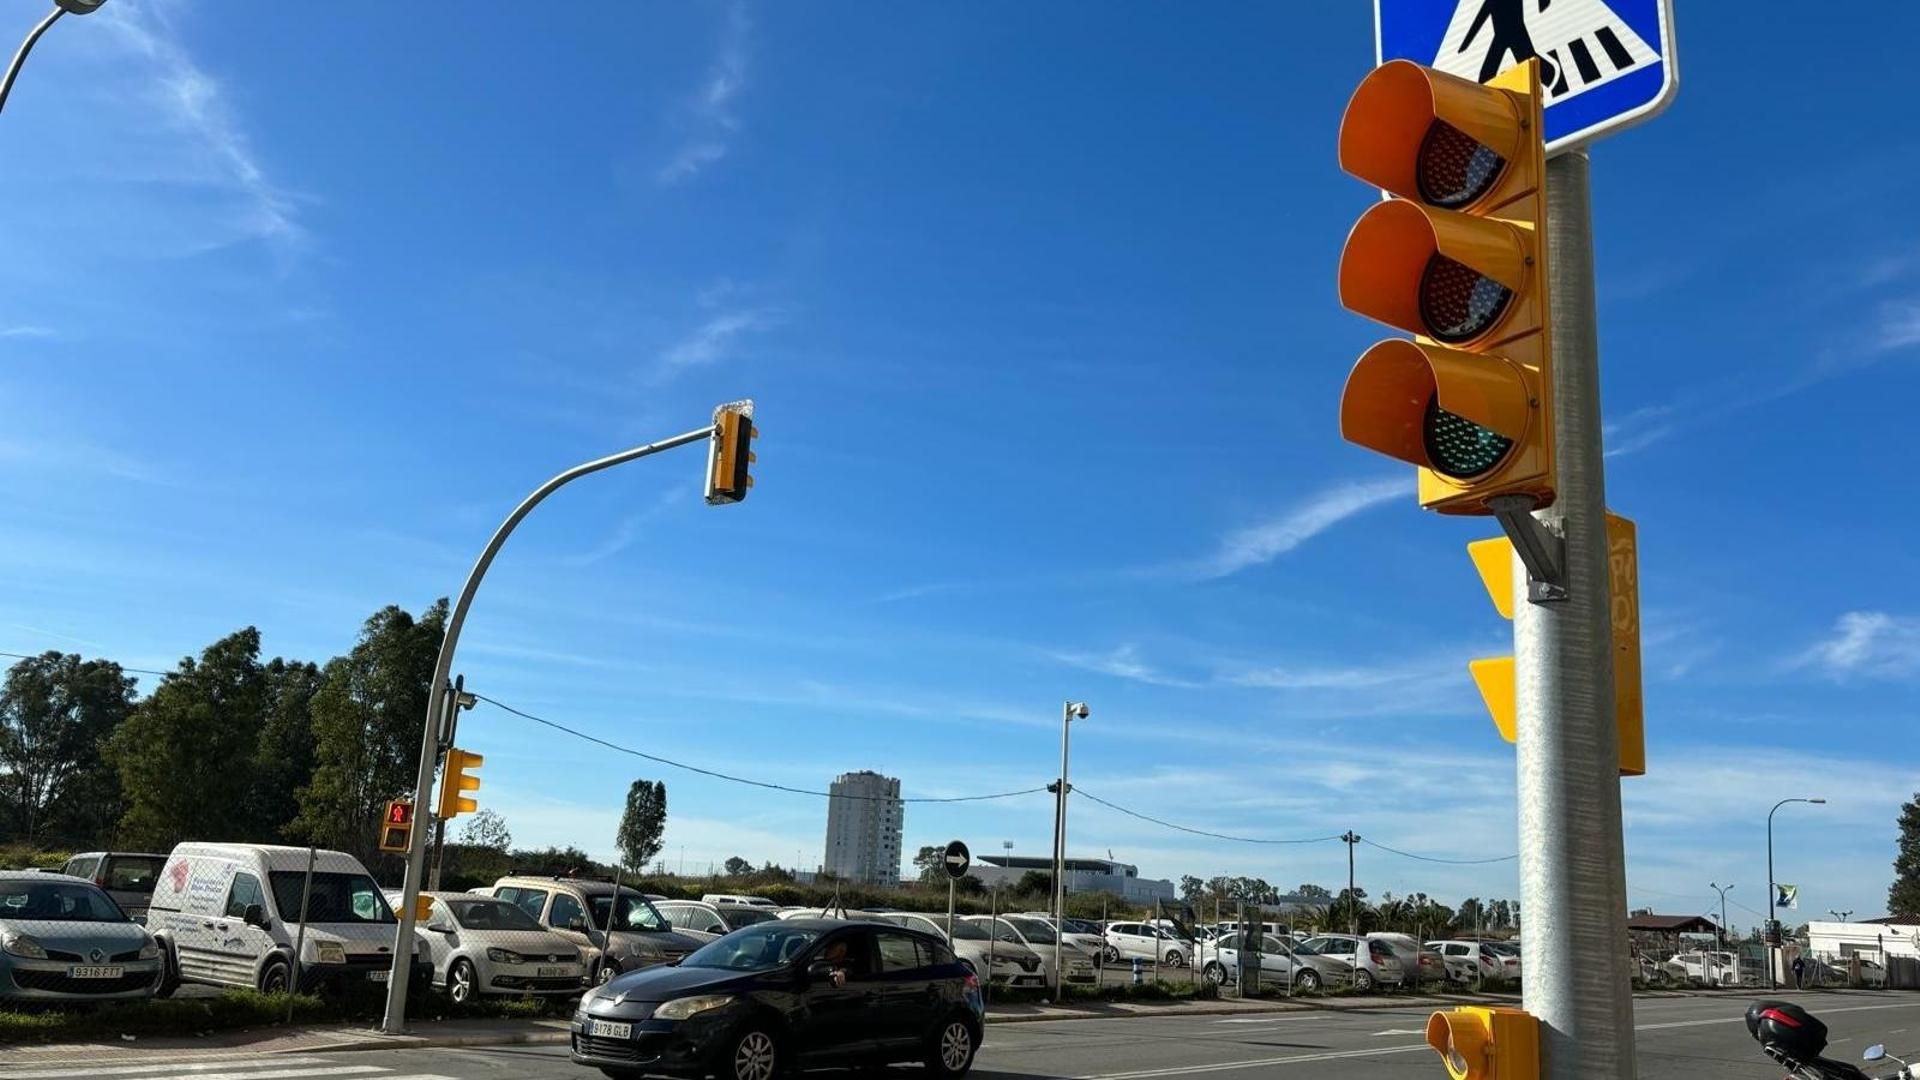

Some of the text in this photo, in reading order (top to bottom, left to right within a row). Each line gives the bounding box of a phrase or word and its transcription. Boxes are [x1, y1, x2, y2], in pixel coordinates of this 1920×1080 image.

[75, 967, 101, 977] 9316
[593, 1022, 630, 1037] 9178 GLB
